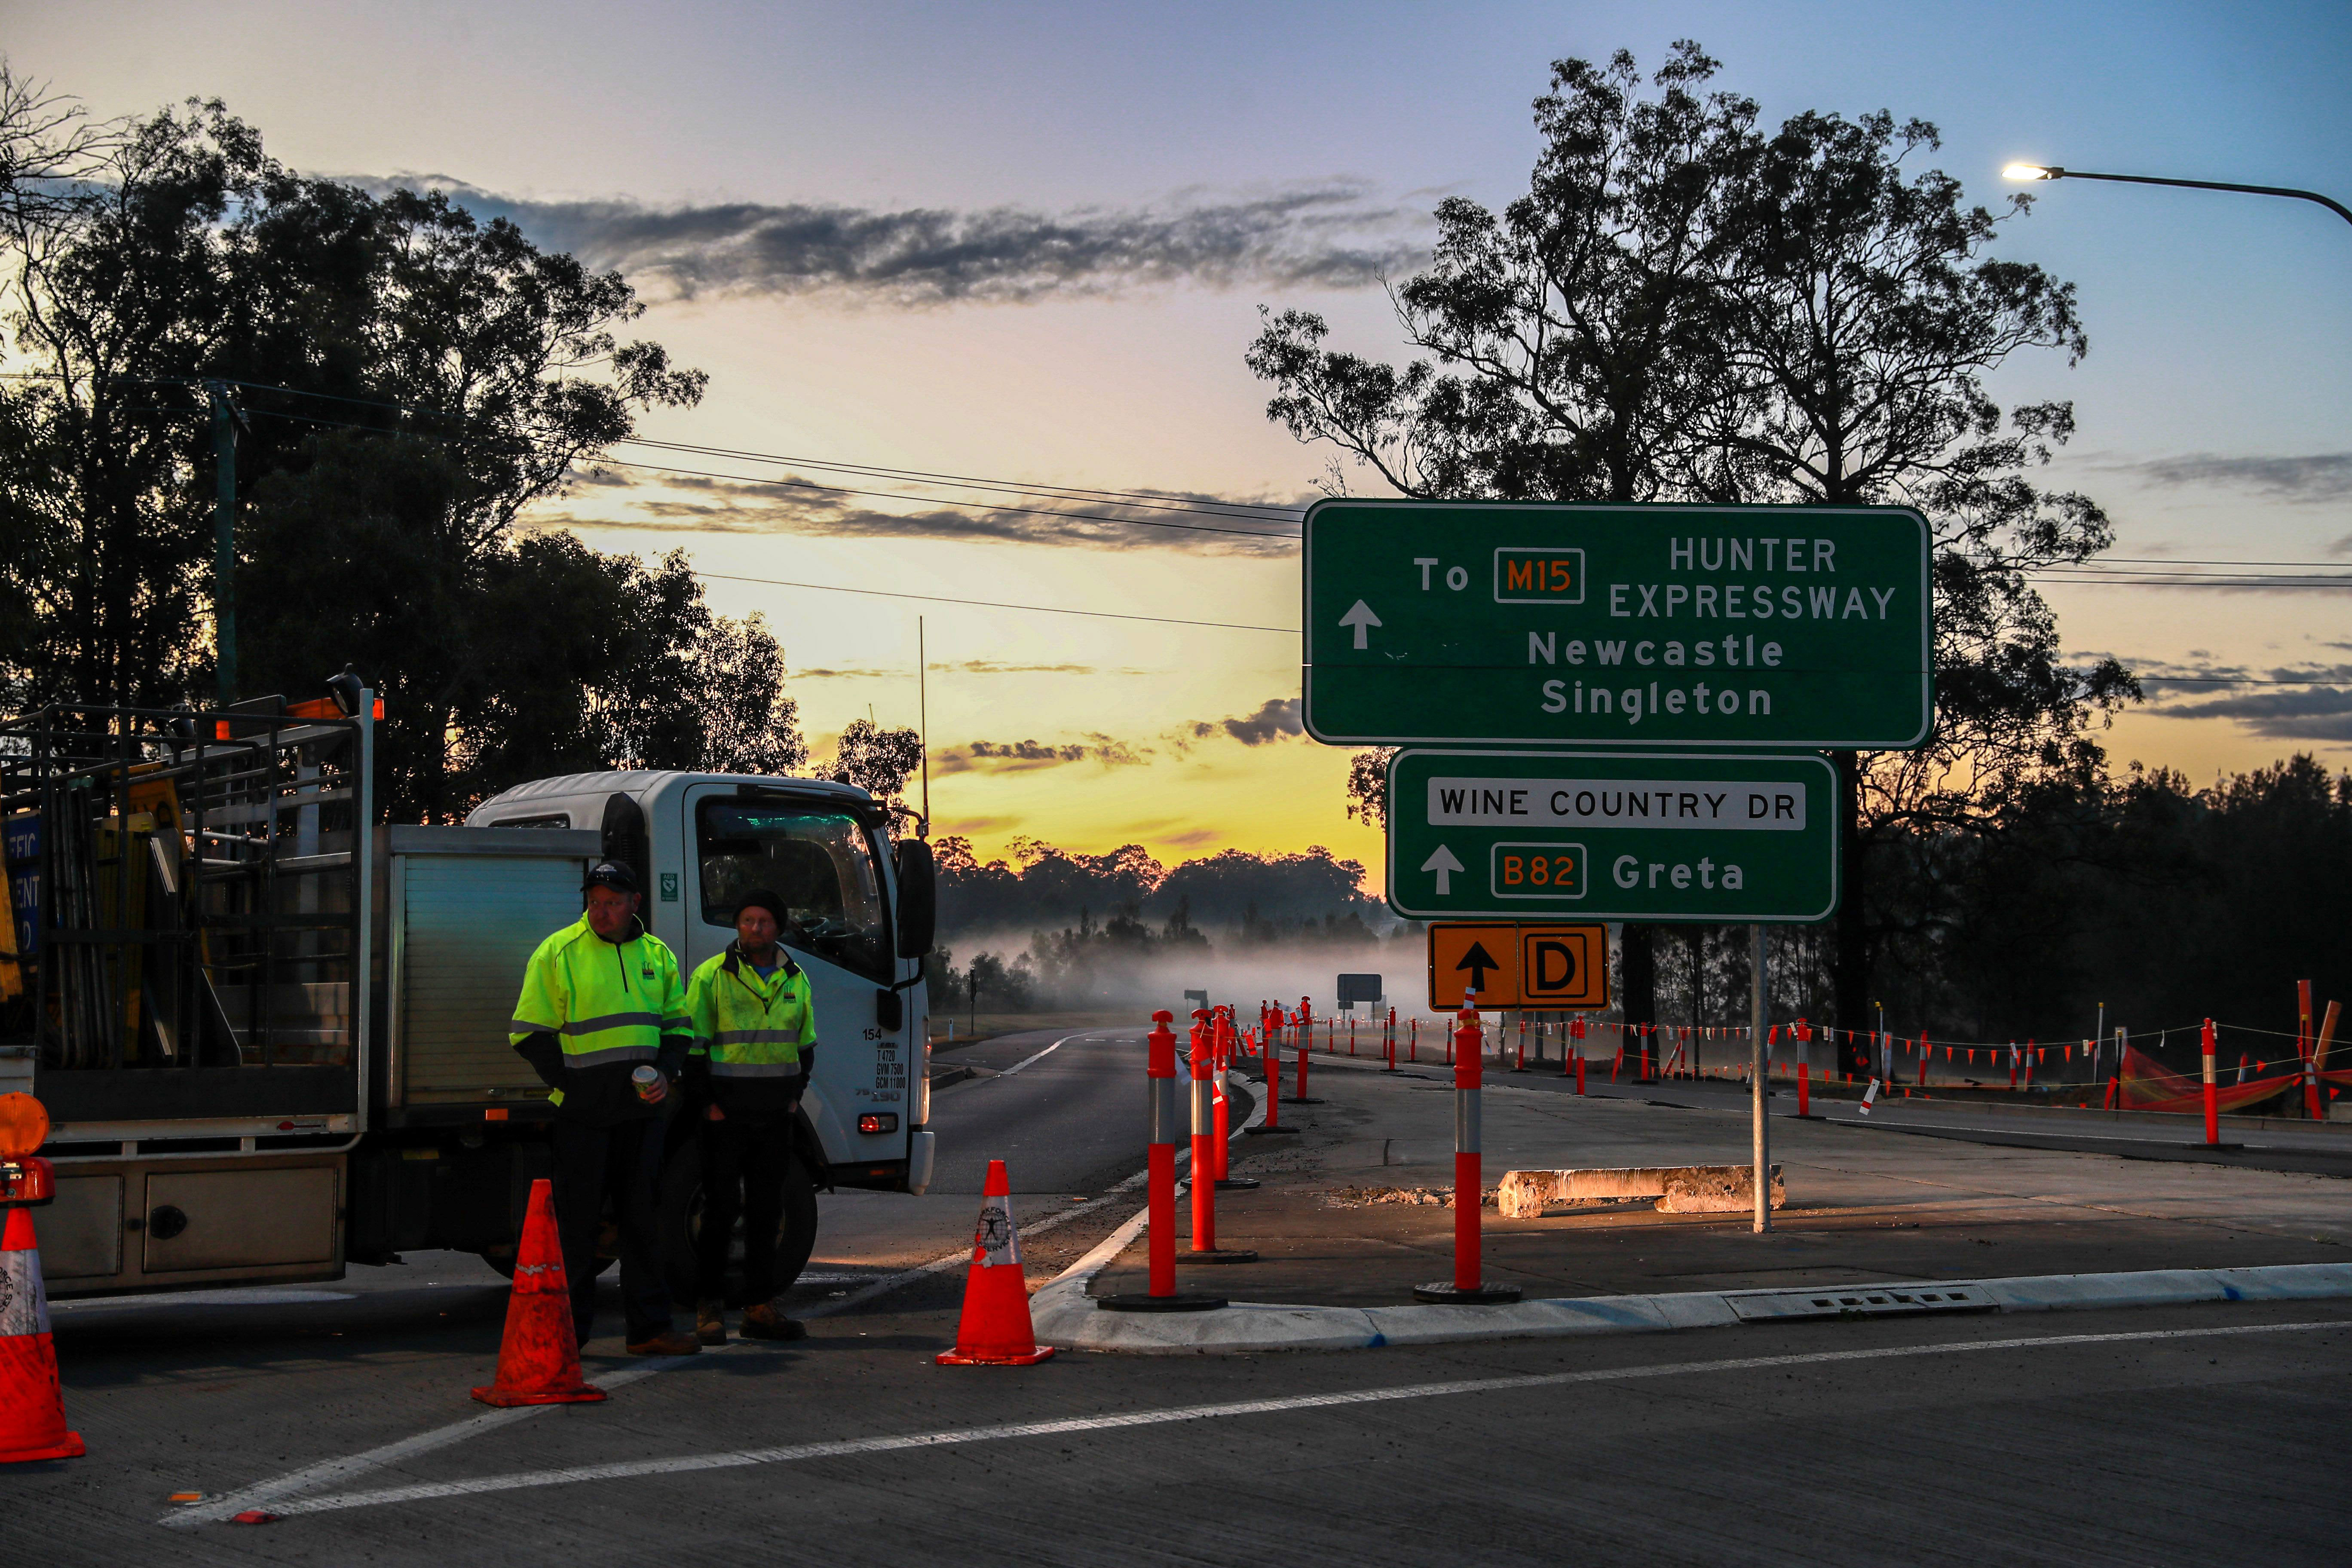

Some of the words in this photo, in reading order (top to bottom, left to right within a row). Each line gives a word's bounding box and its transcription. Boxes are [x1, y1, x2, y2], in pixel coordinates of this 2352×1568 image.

[1671, 537, 1835, 572] HUNTER
[1414, 557, 1469, 591] To
[1507, 560, 1571, 591] M15
[1610, 584, 1896, 620] EXPRESSWAY
[1528, 631, 1783, 666] Newcastle
[1541, 680, 1771, 725] Singleton
[1440, 789, 1528, 815] WINE
[1550, 790, 1727, 818] COUNTRY
[1748, 794, 1795, 819] DR
[1504, 855, 1574, 886] B82
[1613, 855, 1743, 890] Greta
[1536, 941, 1576, 991] D
[863, 1028, 882, 1040] 154
[876, 1063, 889, 1075] GVM
[891, 1063, 903, 1075] 7500
[877, 1050, 881, 1061] T
[882, 1050, 895, 1062] 4720
[876, 1077, 888, 1089] GCM
[890, 1077, 905, 1089] 11000
